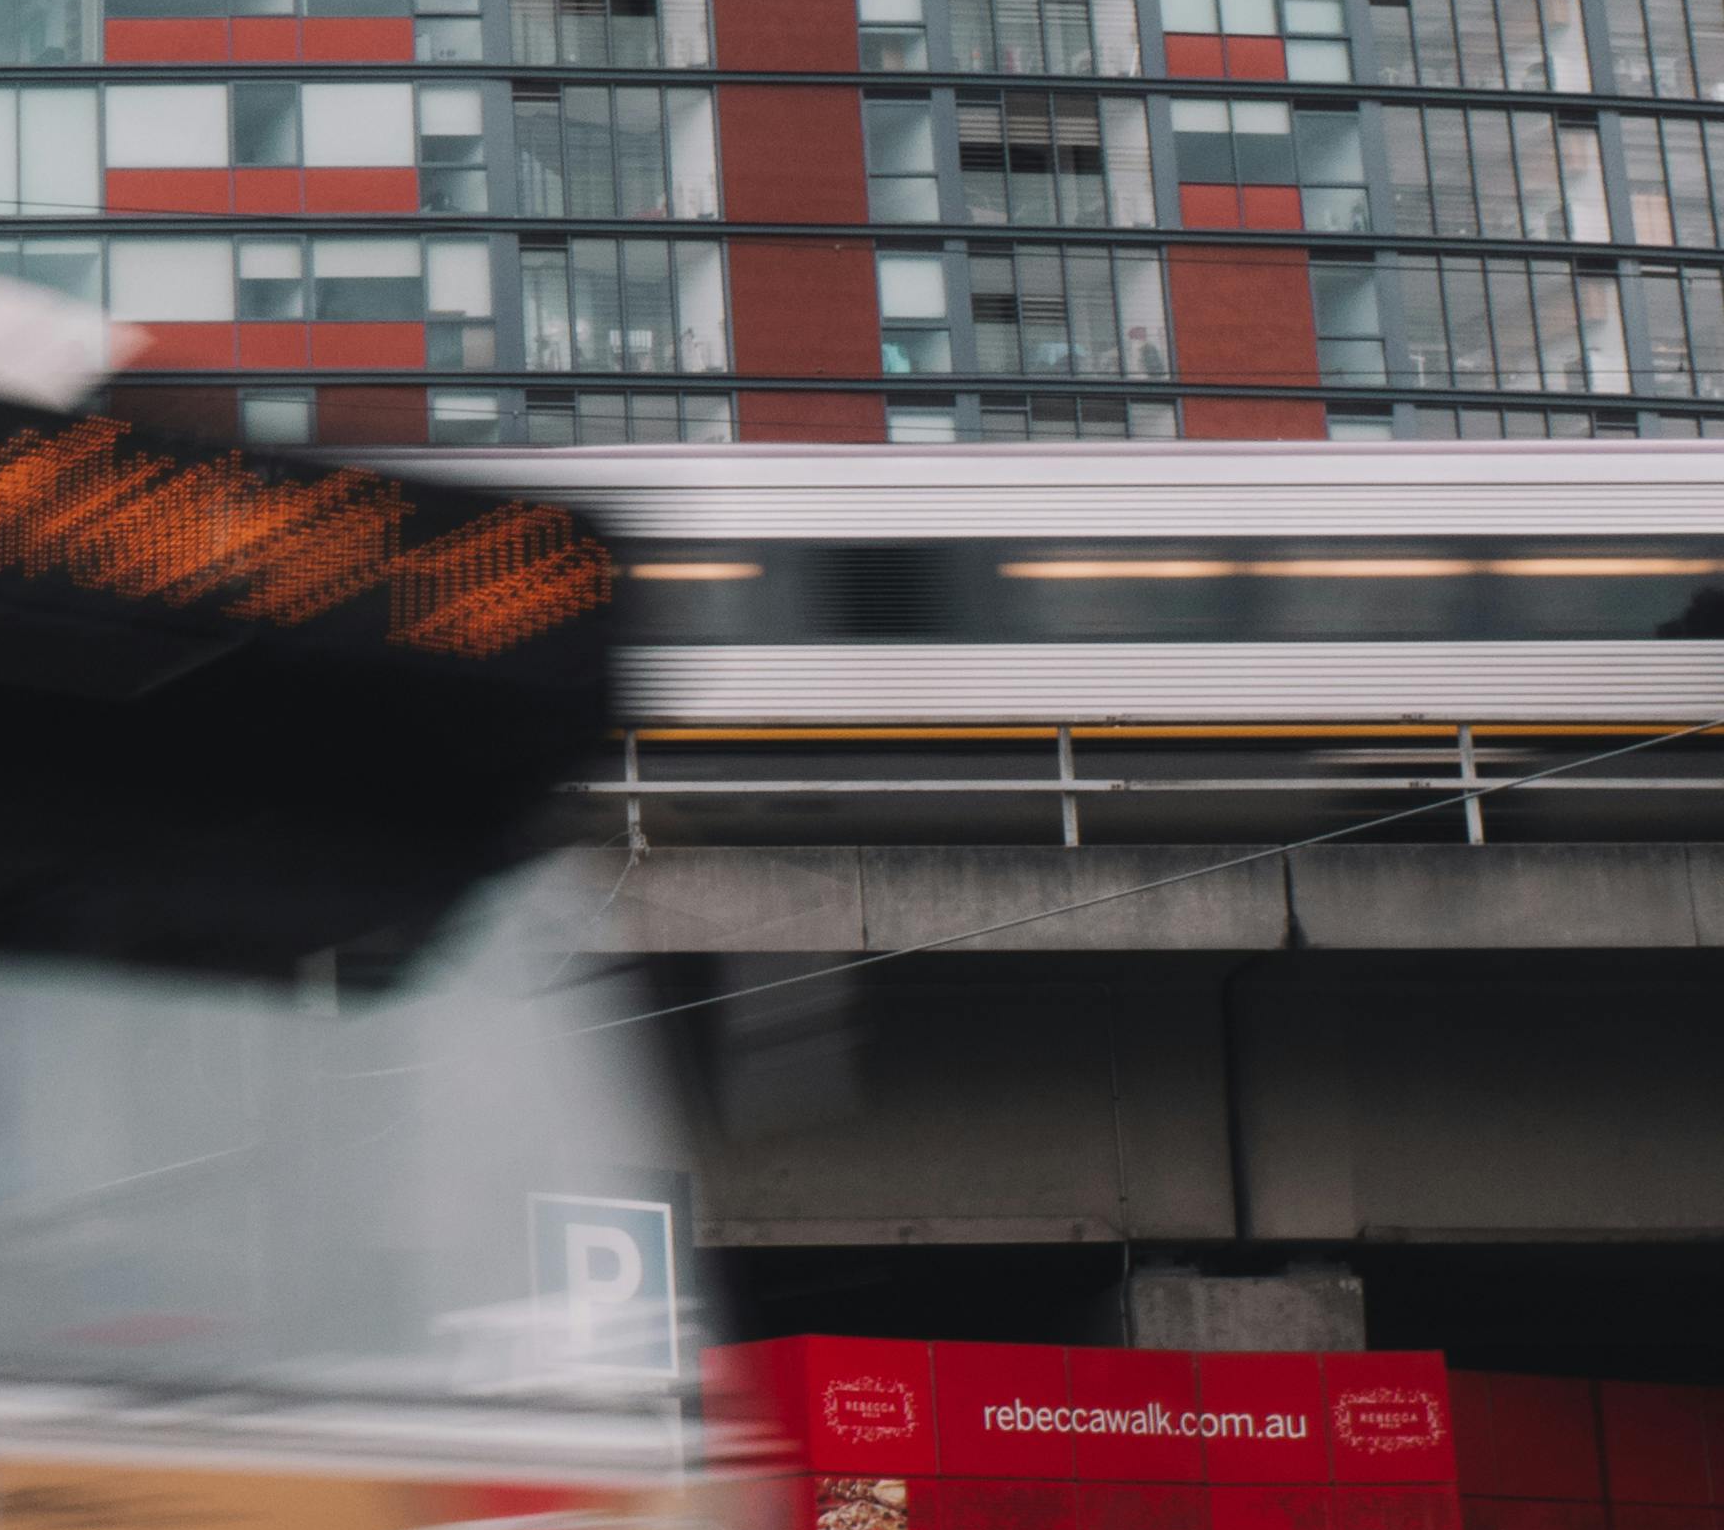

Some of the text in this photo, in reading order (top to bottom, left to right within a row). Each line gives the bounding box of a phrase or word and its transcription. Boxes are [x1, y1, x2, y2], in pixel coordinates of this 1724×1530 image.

[565, 1223, 643, 1343] P
[845, 1400, 897, 1413] REBECCA
[984, 1398, 1307, 1439] rebeccawalk.com.au
[1359, 1412, 1418, 1424] REBECCA
